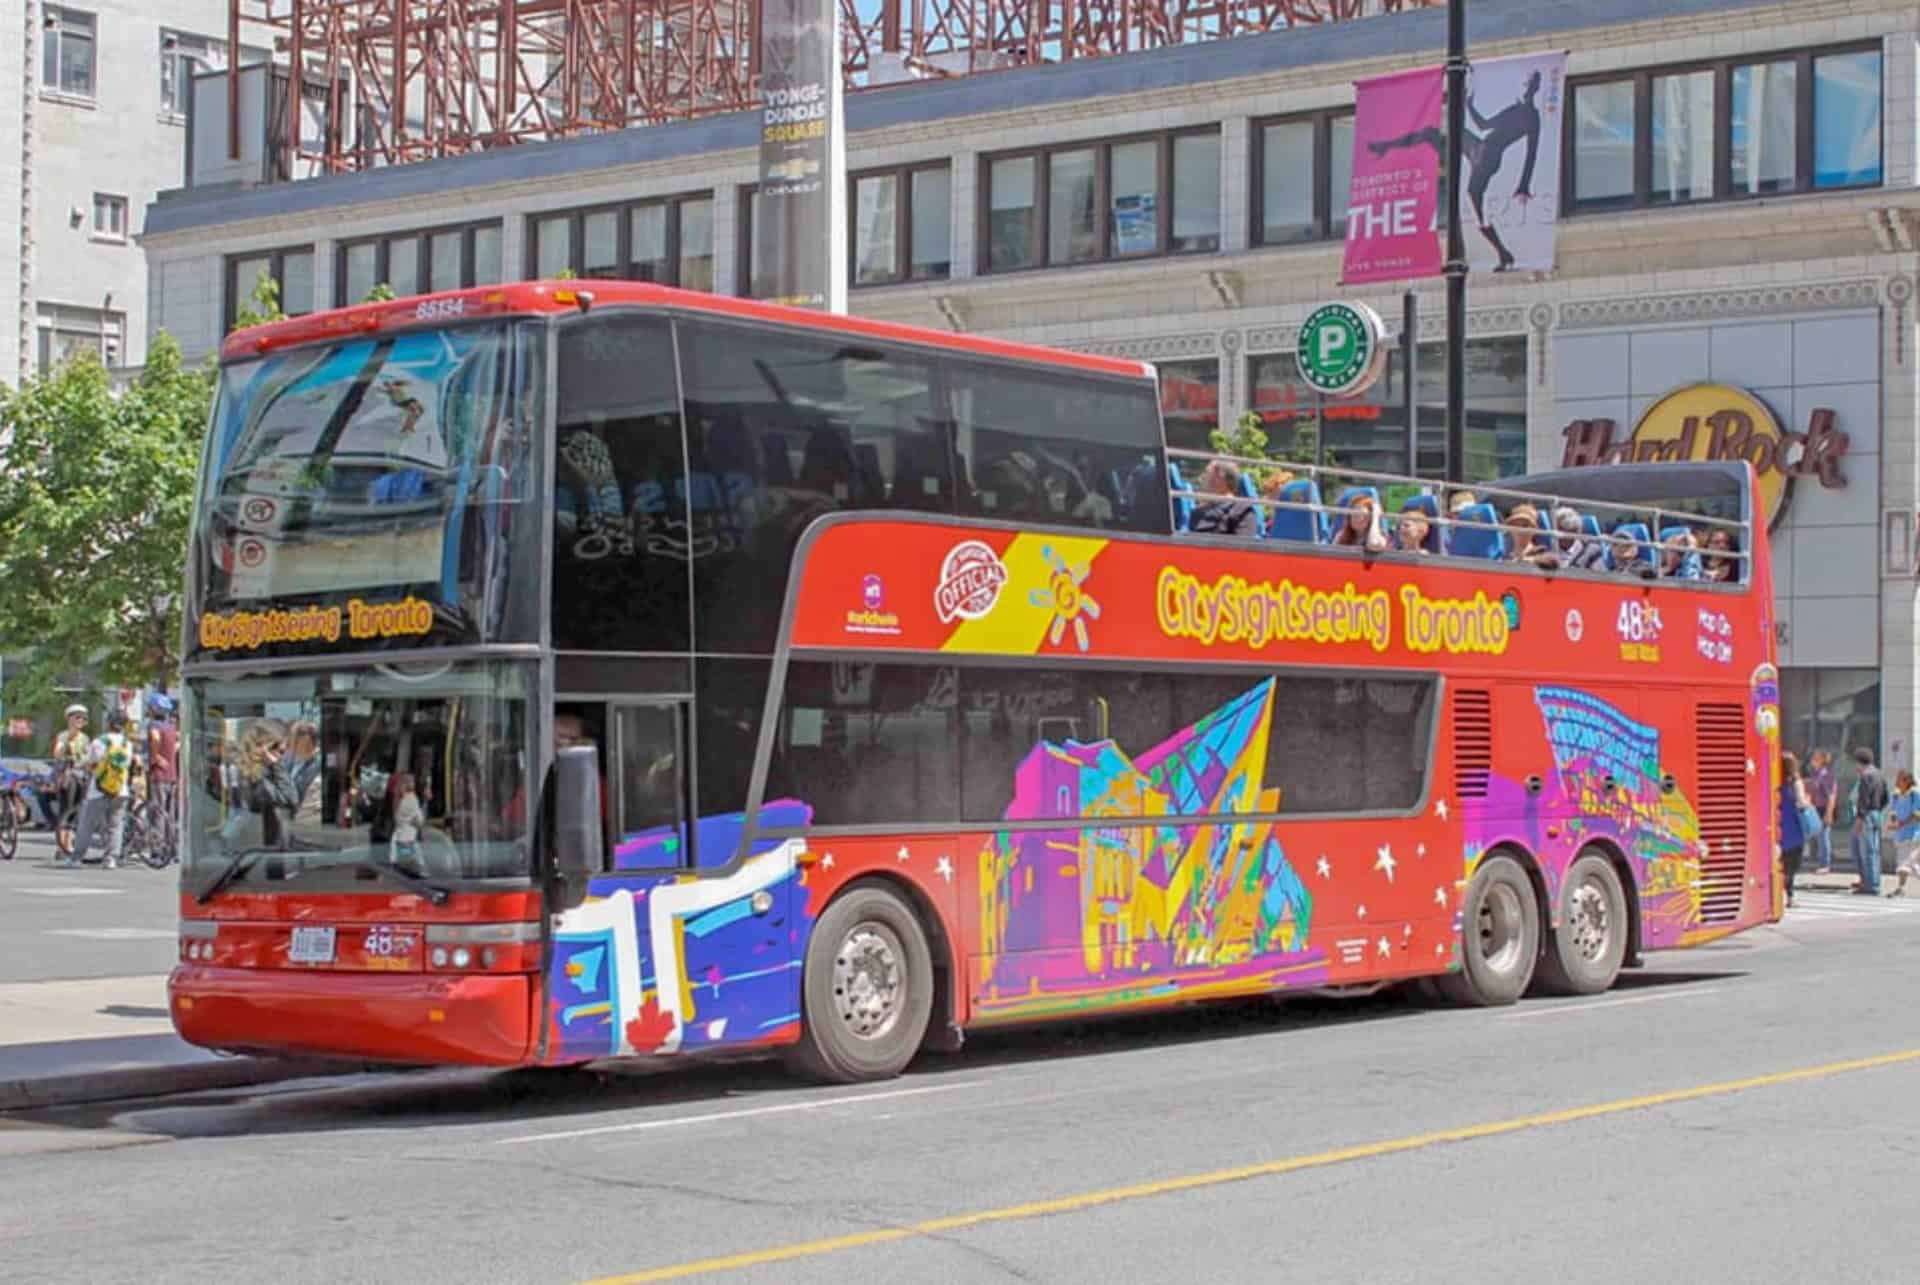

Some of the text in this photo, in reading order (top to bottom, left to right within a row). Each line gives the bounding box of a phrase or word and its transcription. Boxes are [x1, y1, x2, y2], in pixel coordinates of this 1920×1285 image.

[764, 102, 826, 124] DUNDAS
[767, 83, 826, 105] YONGE-
[1346, 199, 1417, 241] THE
[1318, 325, 1346, 362] P
[1562, 408, 1850, 489] Hard Rock
[347, 595, 433, 641] Toronto
[1399, 584, 1509, 655] Toronto
